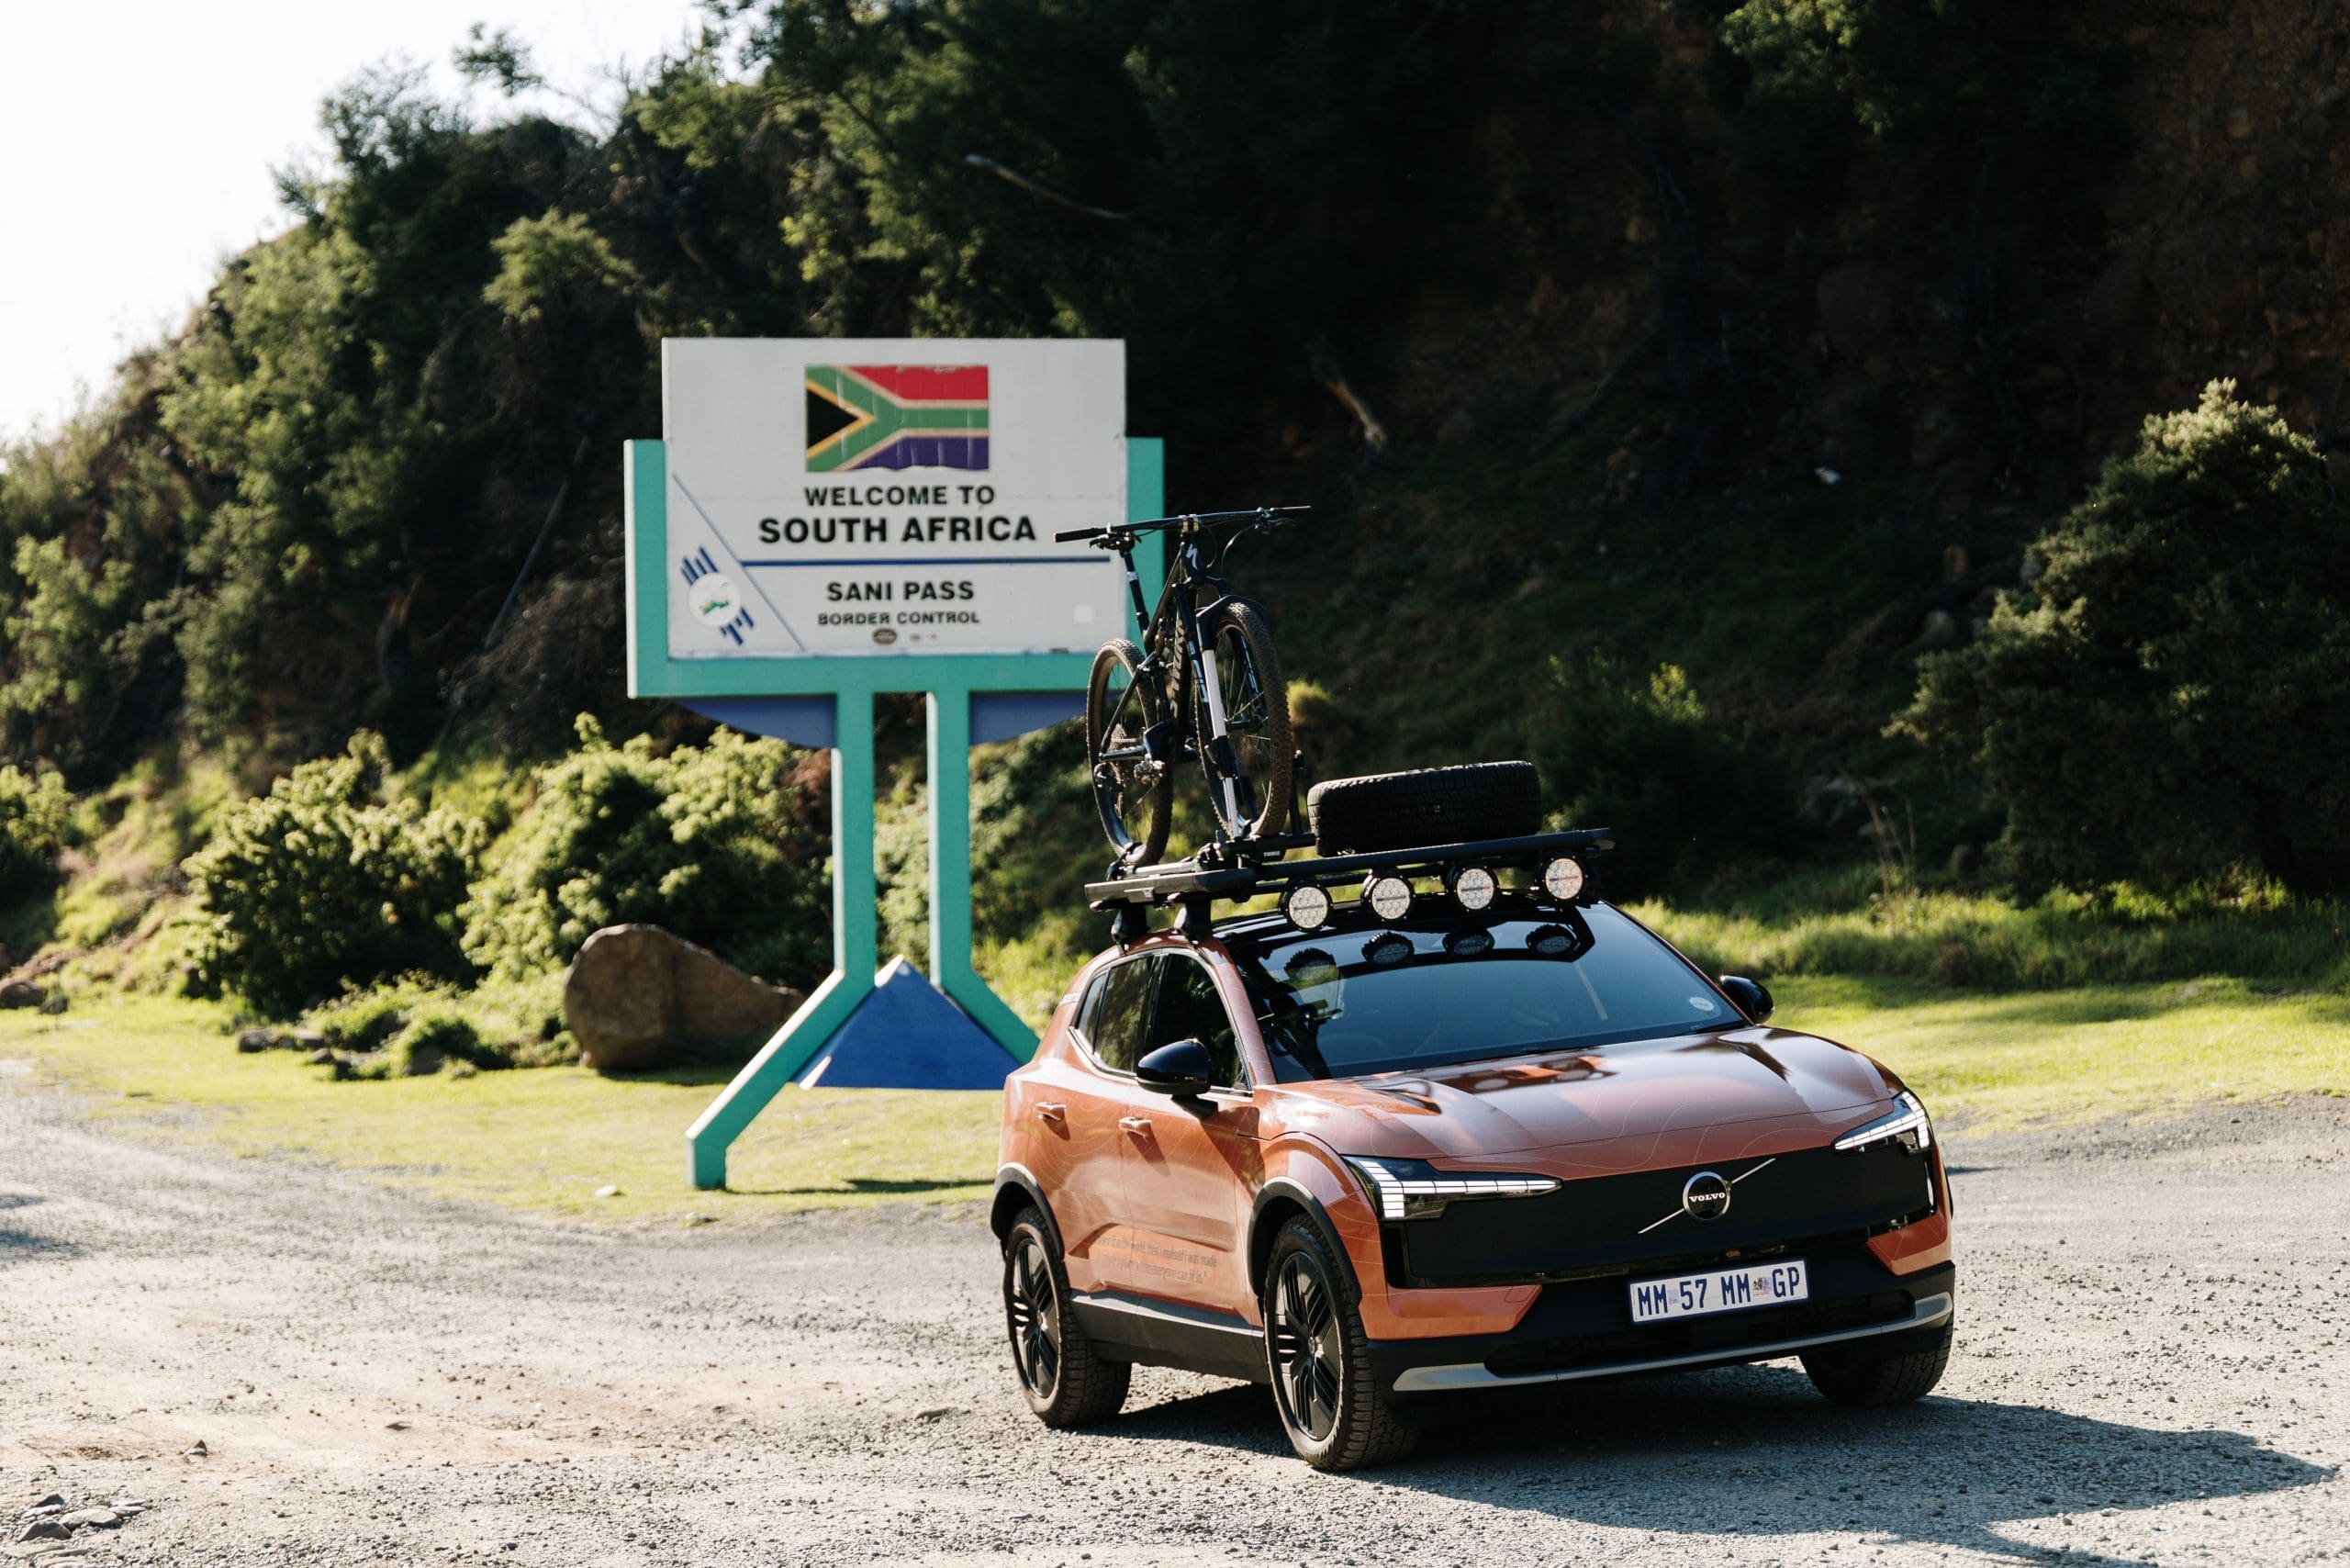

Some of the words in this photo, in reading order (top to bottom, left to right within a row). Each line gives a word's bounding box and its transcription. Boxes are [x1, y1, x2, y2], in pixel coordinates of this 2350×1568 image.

[804, 485, 948, 507] WELCOME
[957, 485, 996, 506] TO
[758, 516, 889, 544] SOUTH
[901, 515, 1036, 543] AFRICA
[826, 581, 893, 602] SANI
[903, 580, 974, 601] PASS
[818, 611, 891, 627] BORDER
[896, 610, 980, 626] CONTROL
[1688, 1192, 1726, 1204] VOLVO
[1637, 1283, 1669, 1316] MM
[1679, 1278, 1708, 1311] 57
[1719, 1272, 1751, 1306] MM
[1771, 1265, 1800, 1299] GP
